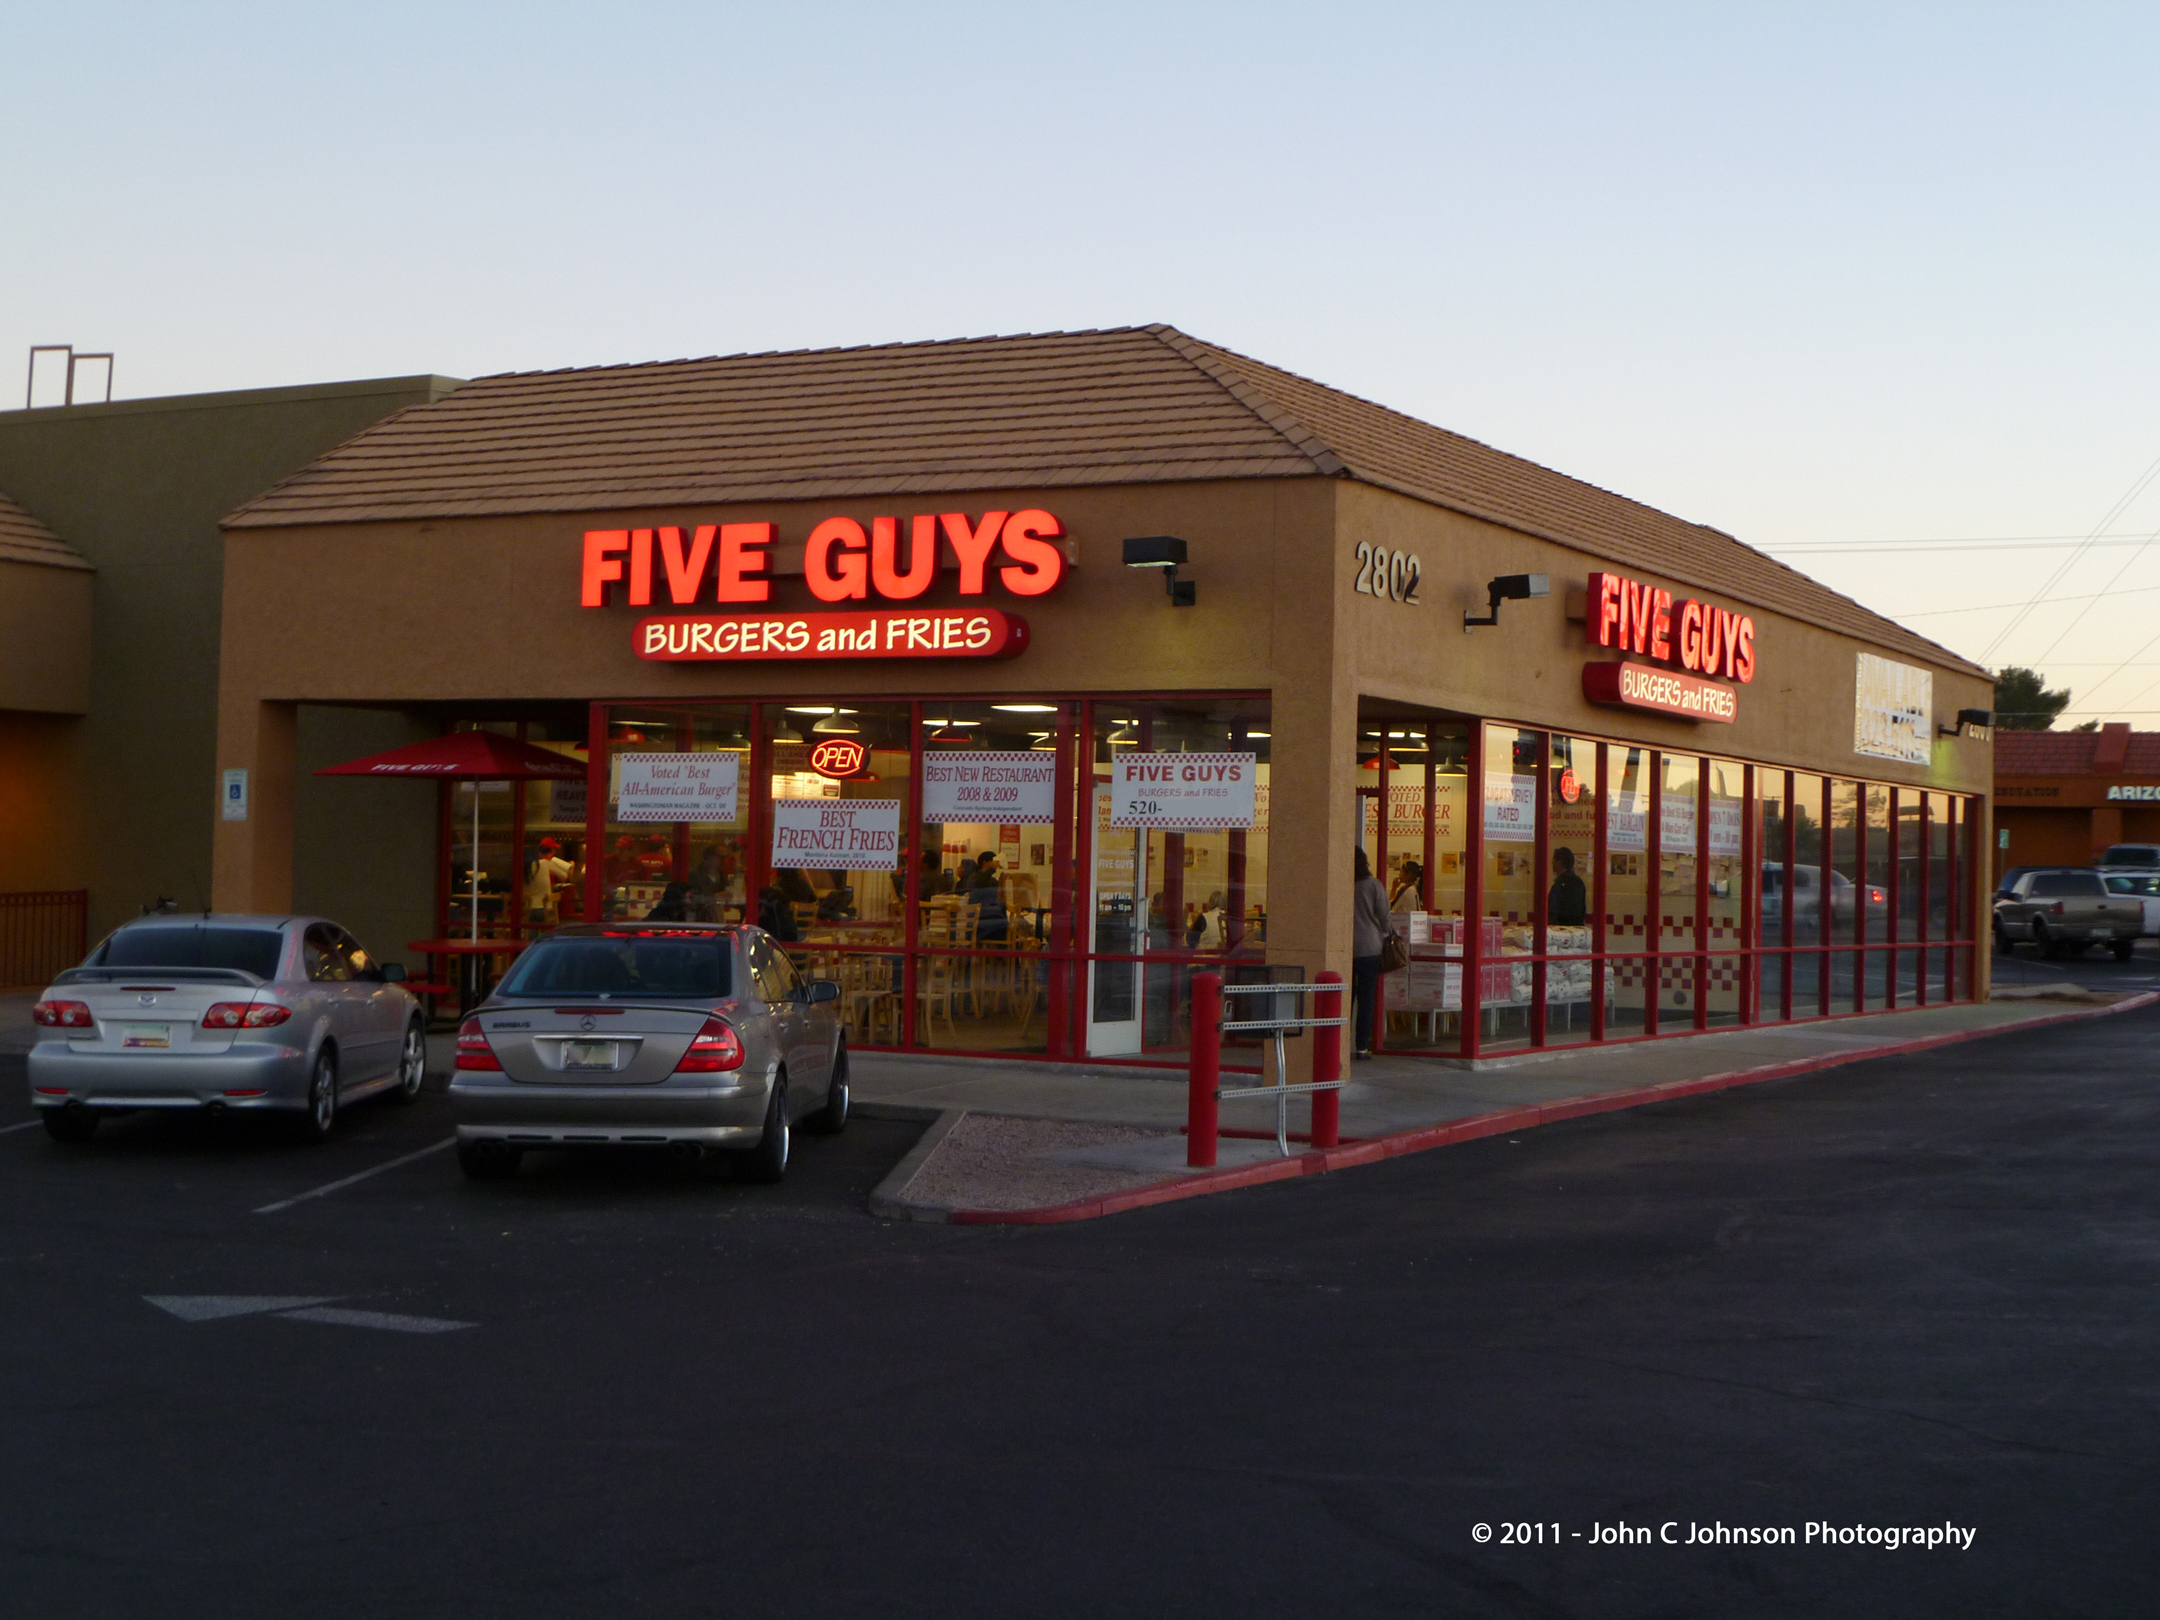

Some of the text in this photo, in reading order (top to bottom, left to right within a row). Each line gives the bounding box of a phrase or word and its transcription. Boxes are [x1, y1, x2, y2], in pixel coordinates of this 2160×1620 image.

[581, 508, 1068, 607] FIVE GUYS
[1354, 540, 1421, 606] 2802
[644, 616, 993, 655] BURGERS and FRIES
[1595, 572, 1756, 684] FIVE GUYS
[1623, 668, 1734, 717] BURGERS and FRIES
[812, 747, 865, 768] OPEN
[370, 763, 412, 771] FIVE
[651, 764, 681, 779] Voted
[925, 765, 1055, 783] BEST NEW RESTAURANT
[1125, 765, 1242, 782] FIVE GUYS
[555, 789, 587, 801] HEAVE
[621, 781, 737, 800] All-American Burger"
[957, 786, 1019, 801] 2008 & 2009
[1138, 788, 1229, 798] BURGERS and FRIES
[1388, 792, 1421, 803] OTED
[819, 810, 857, 828] BEST
[1497, 806, 1520, 822] RATED
[776, 826, 896, 852] FRENCH FRIES
[1098, 859, 1134, 869] FIVE GUYS
